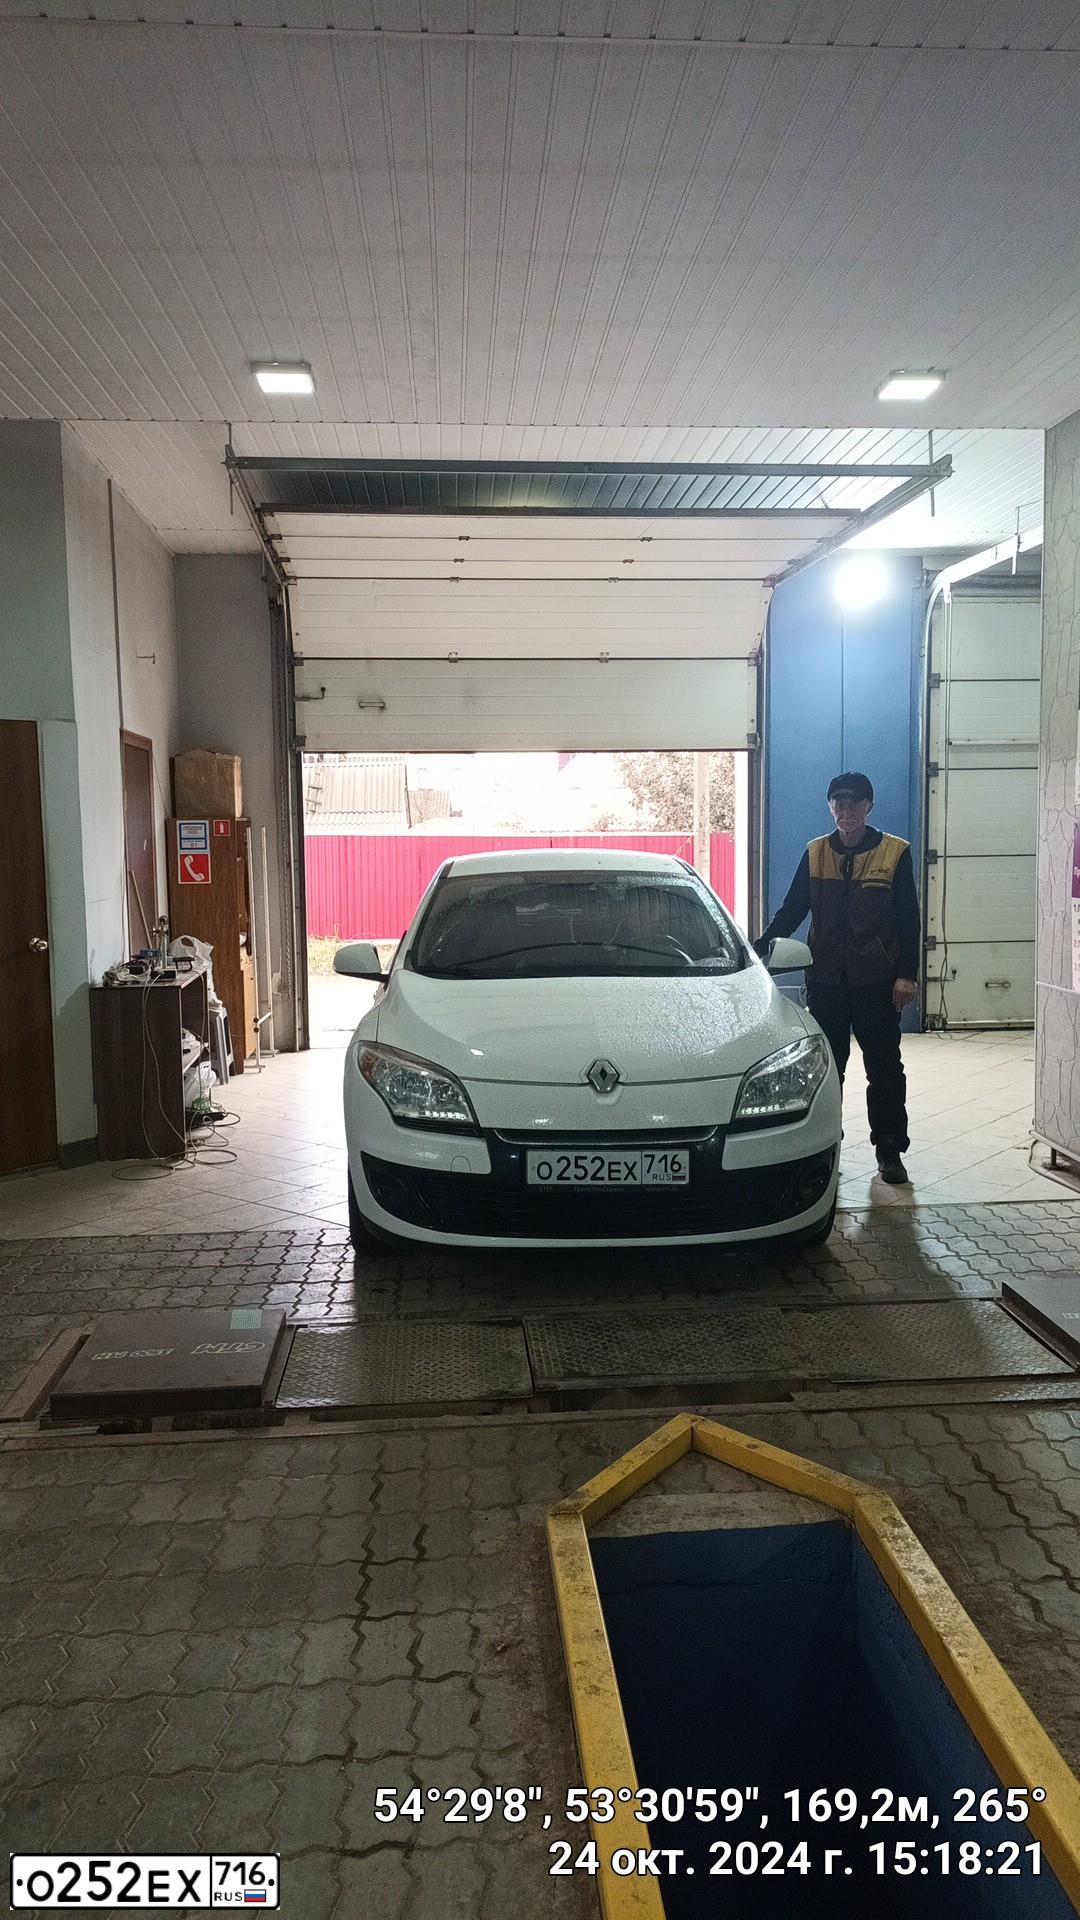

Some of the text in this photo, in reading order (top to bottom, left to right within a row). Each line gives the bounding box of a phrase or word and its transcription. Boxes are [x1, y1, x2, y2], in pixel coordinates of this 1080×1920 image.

[536, 1154, 682, 1181] О252ЕХ 716
[652, 1173, 672, 1181] RUS
